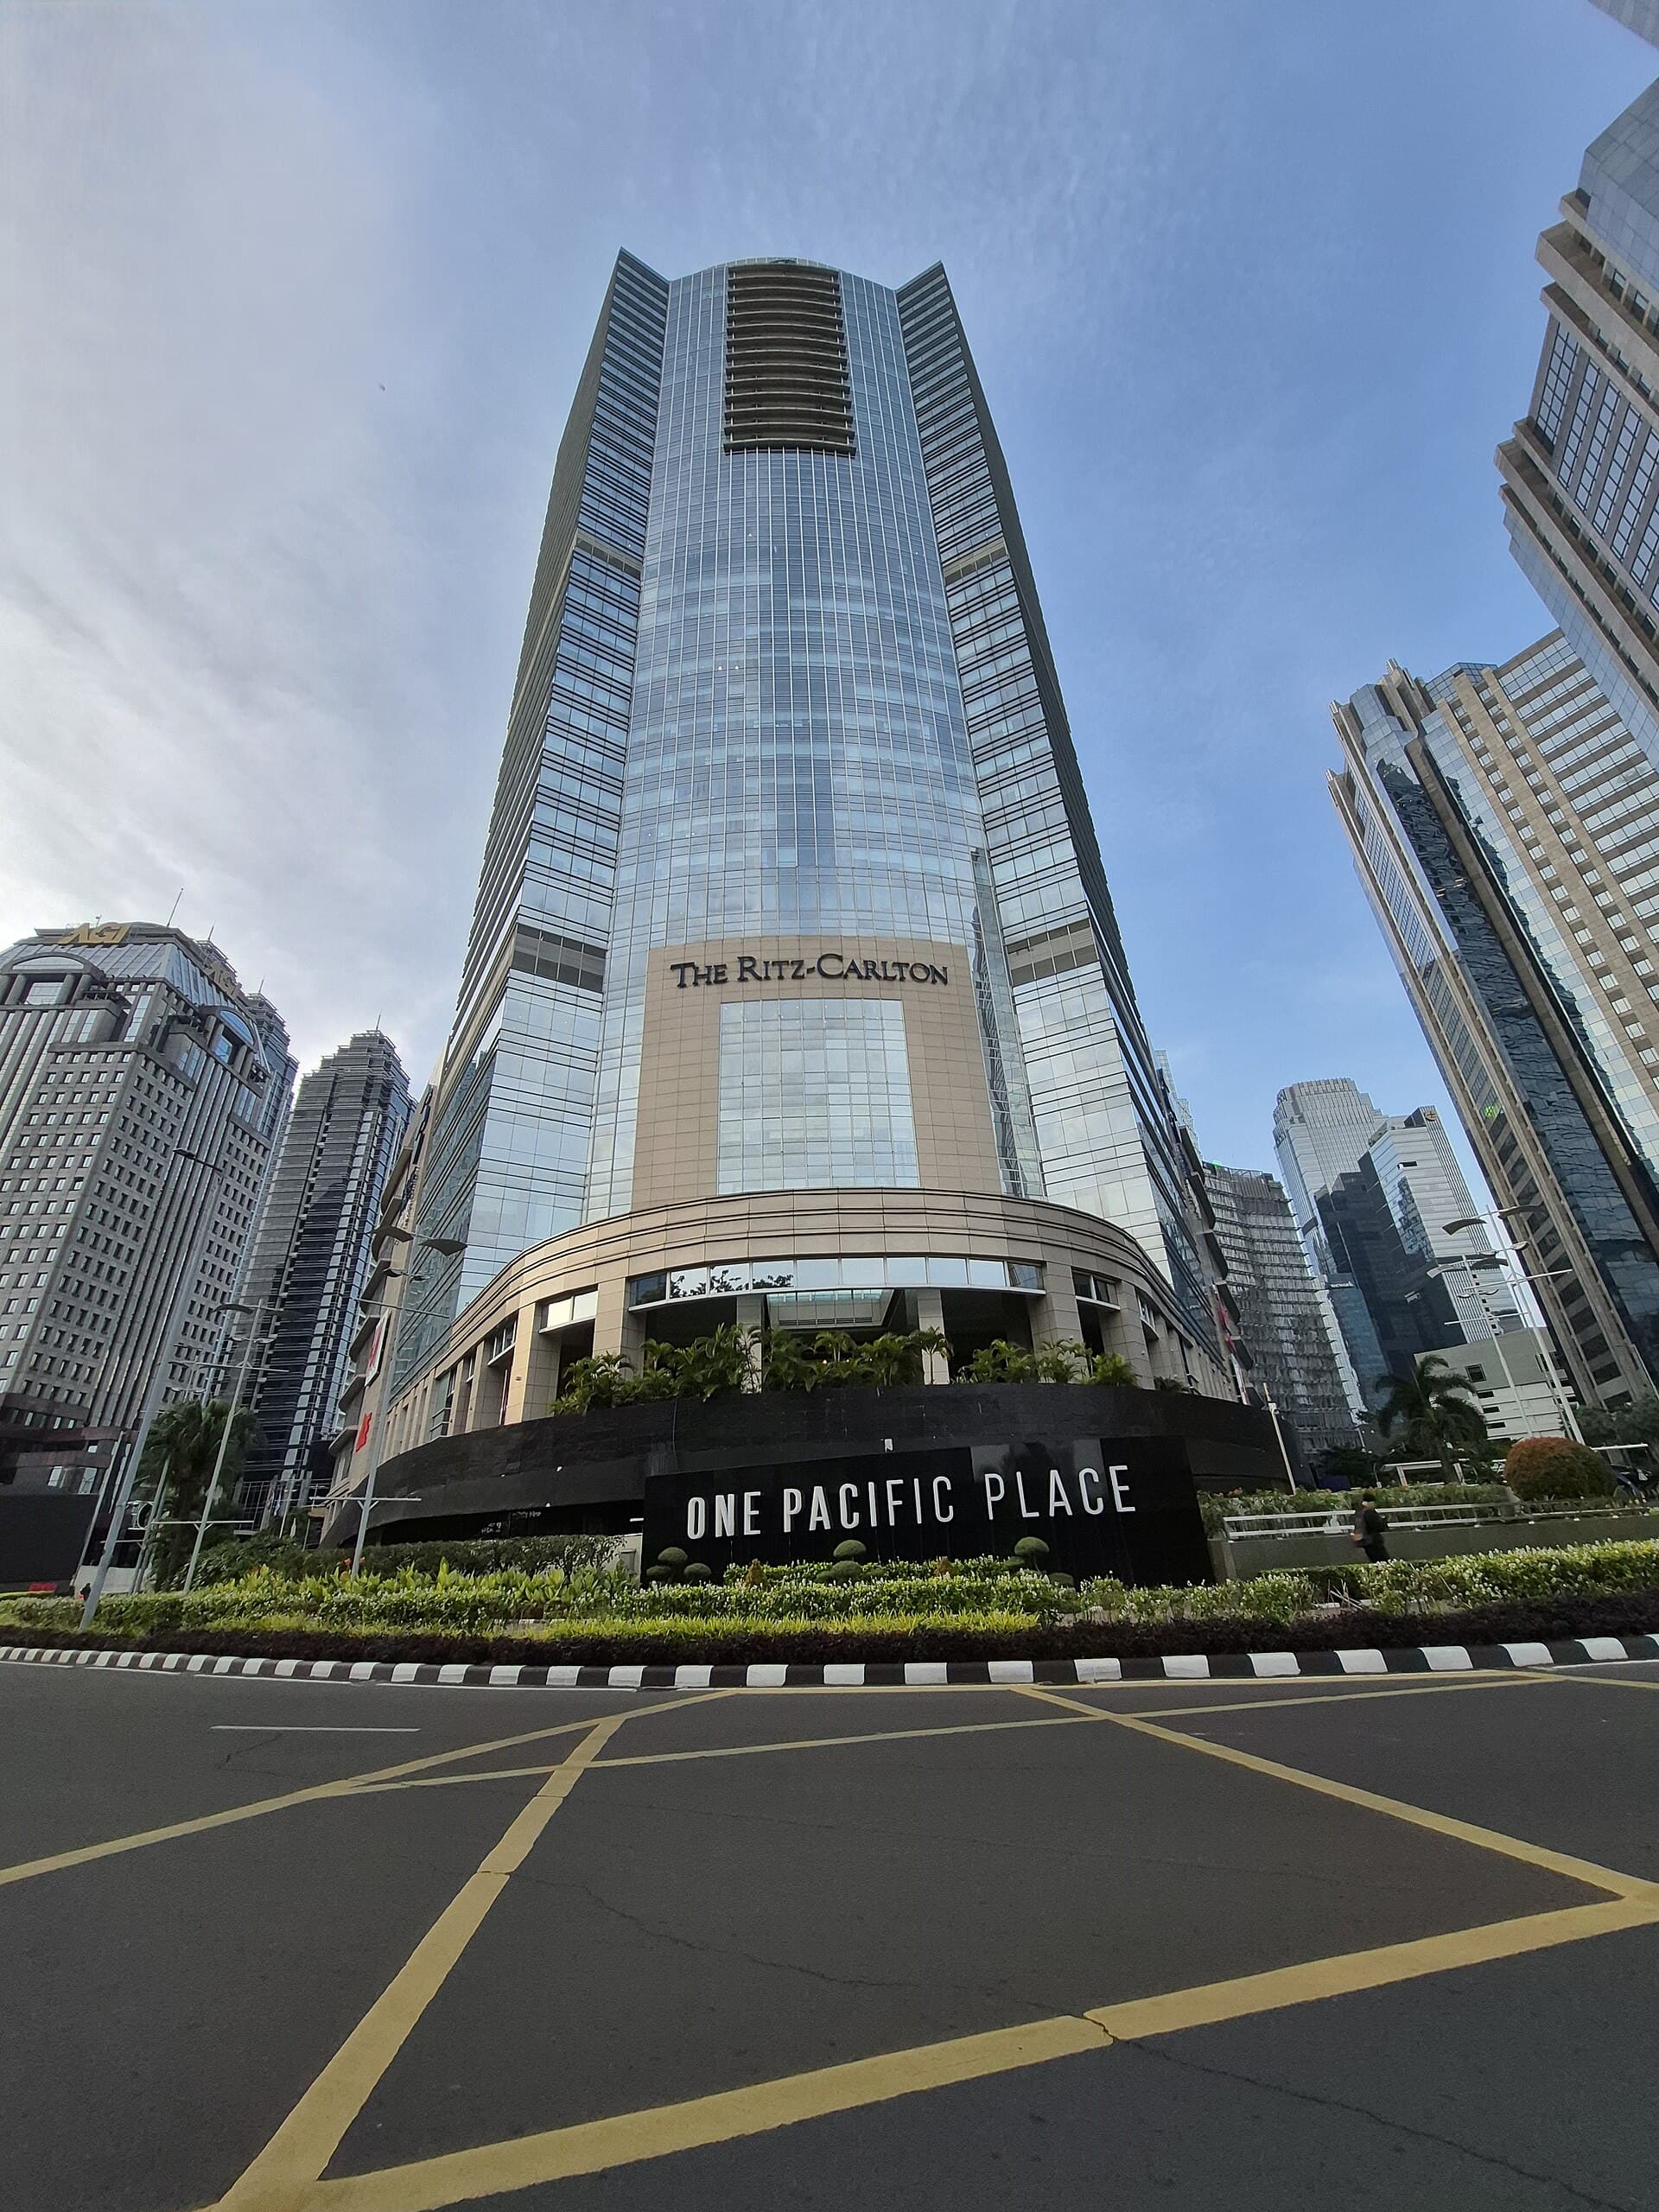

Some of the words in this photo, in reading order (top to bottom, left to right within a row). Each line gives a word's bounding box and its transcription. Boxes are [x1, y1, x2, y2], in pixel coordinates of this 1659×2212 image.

[671, 962, 728, 988] THE
[687, 1491, 761, 1540] ONE
[784, 1476, 954, 1533] PACIFIC
[984, 1465, 1136, 1520] PLACE
